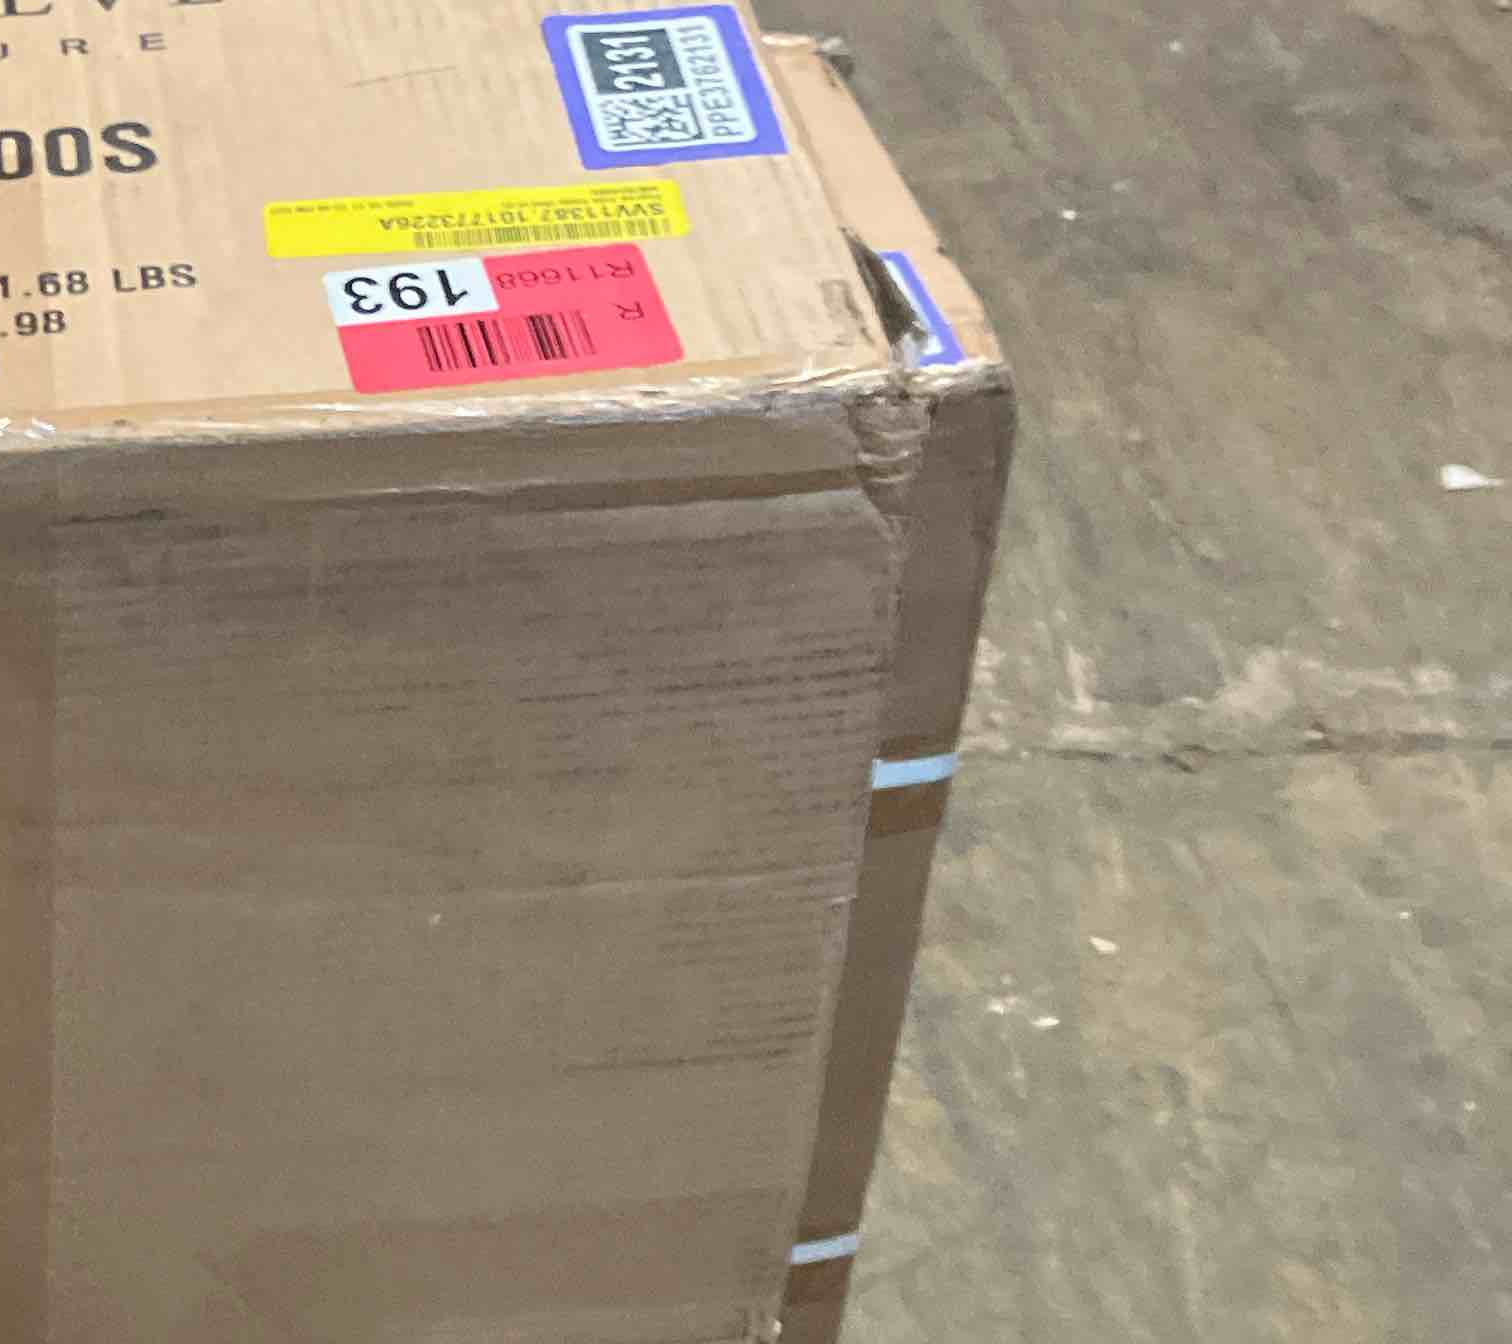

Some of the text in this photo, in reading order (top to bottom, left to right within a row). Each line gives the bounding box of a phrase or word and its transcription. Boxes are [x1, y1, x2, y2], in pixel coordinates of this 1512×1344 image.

[599, 35, 665, 91] 2131
[676, 25, 744, 138] PPE3762131
[112, 262, 198, 293] LBS
[342, 267, 469, 316] 193
[496, 258, 636, 291] R11668
